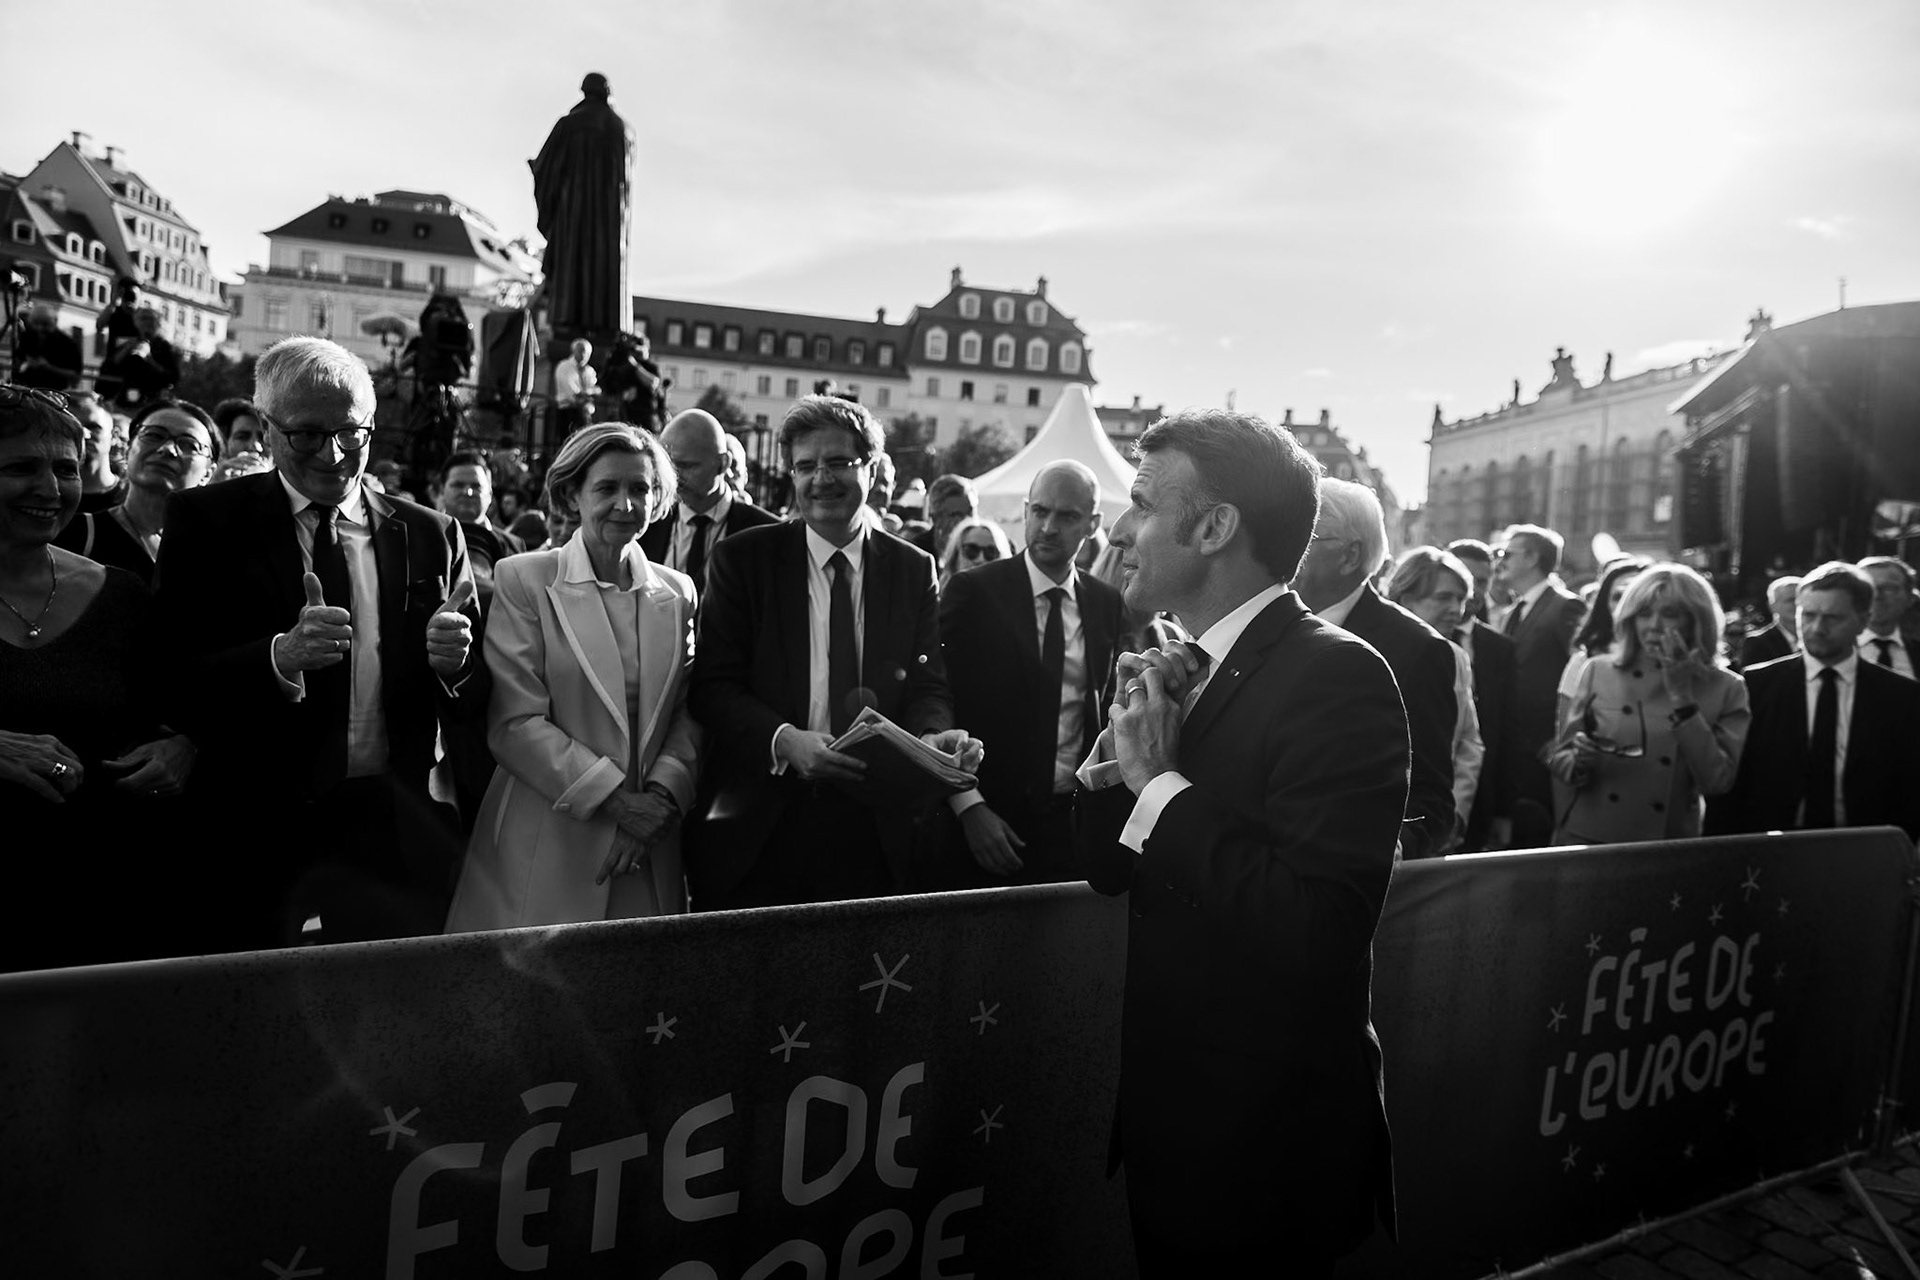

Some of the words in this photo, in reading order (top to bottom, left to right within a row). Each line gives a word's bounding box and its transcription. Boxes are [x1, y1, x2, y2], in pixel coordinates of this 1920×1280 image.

[1581, 927, 1695, 1035] FÊTE
[1705, 932, 1760, 1011] DE
[386, 1081, 740, 1280] FÊTE
[782, 1062, 925, 1205] DE
